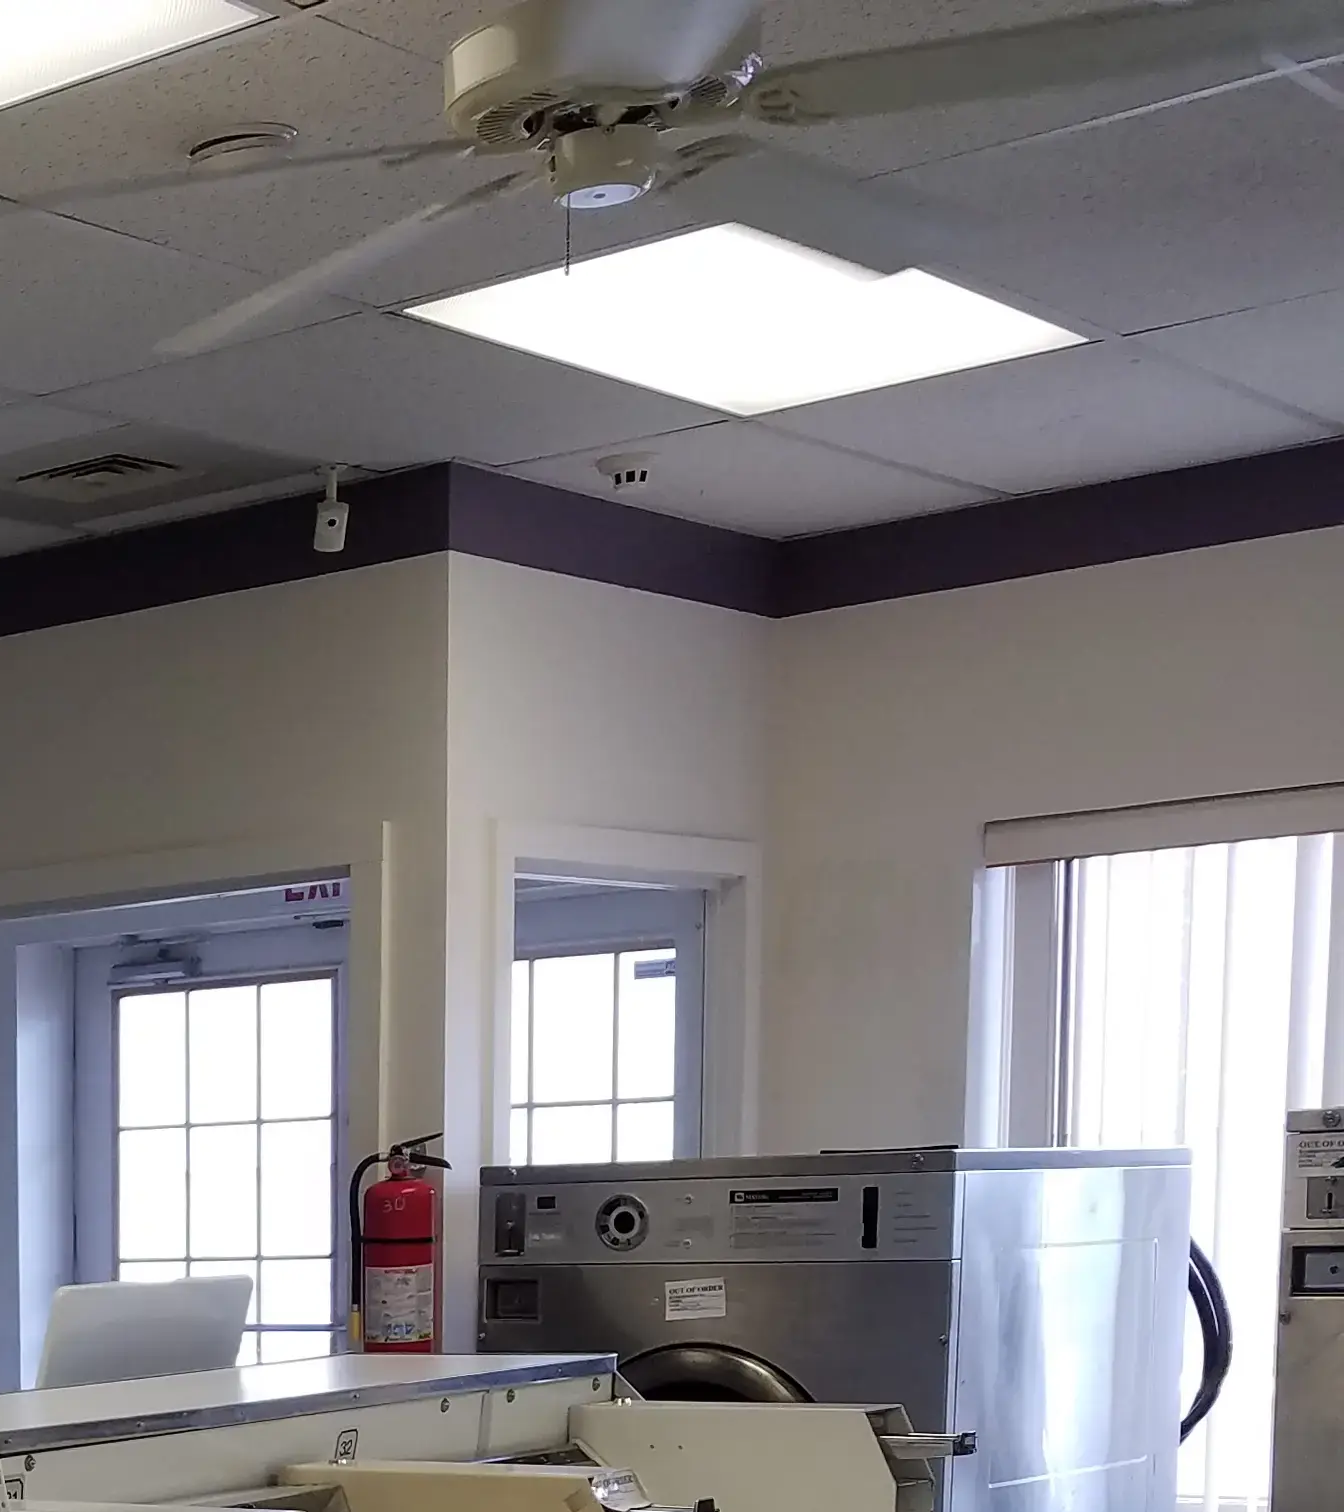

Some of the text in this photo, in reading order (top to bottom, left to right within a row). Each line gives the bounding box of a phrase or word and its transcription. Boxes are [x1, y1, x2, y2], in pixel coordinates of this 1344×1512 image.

[668, 1287, 684, 1295] OUT
[697, 1284, 724, 1292] ORDER
[339, 1439, 354, 1456] 32
